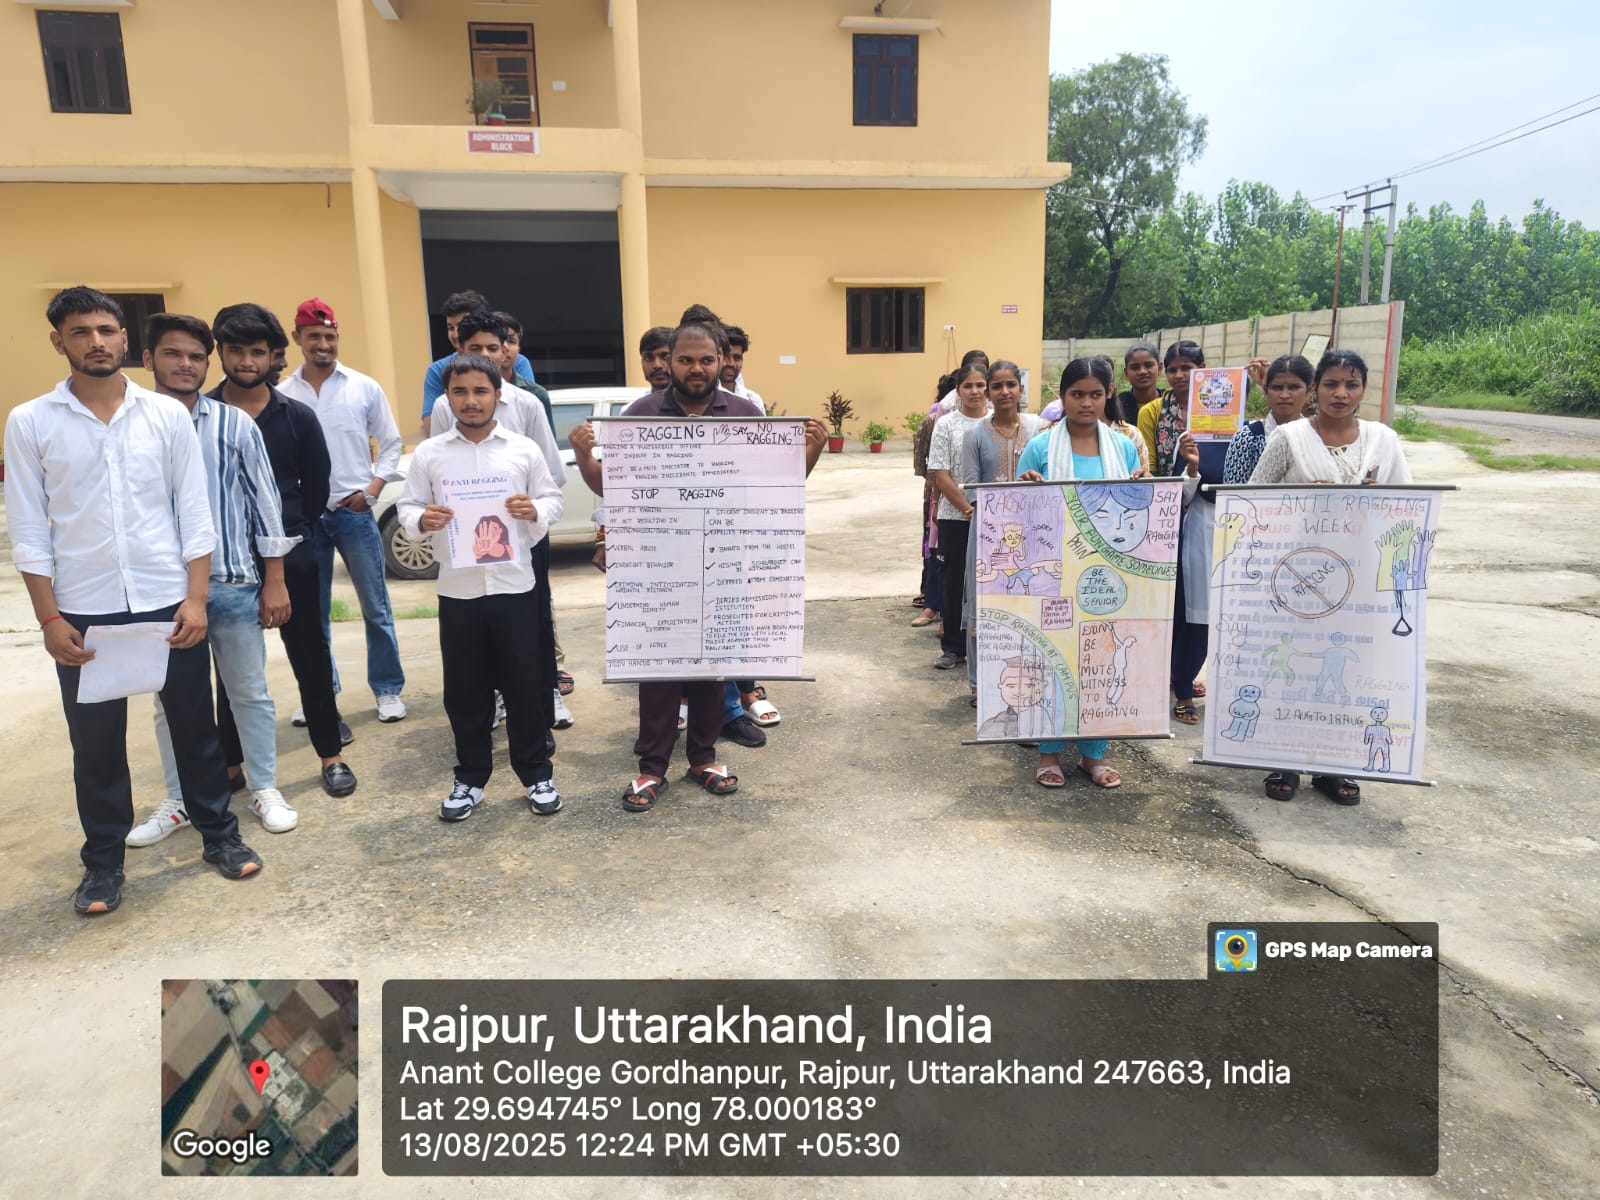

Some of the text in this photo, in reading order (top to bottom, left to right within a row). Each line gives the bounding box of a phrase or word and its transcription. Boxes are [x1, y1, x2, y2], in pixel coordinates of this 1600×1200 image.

[472, 132, 530, 143] ADMINISTRATION
[490, 143, 513, 151] BLOCK
[635, 424, 705, 442] RAGGING
[731, 423, 805, 436] SAY NO TO
[746, 432, 792, 445] RAGGING
[631, 488, 724, 502] STOP RAGGING
[1154, 490, 1179, 503] SAY
[1278, 493, 1425, 514] ANTI RAGGING
[1066, 495, 1089, 527] YOUR
[1159, 504, 1179, 517] NO
[709, 518, 735, 526] CAN BE
[1157, 518, 1175, 529] TO
[1304, 518, 1353, 535] WEEK
[1091, 568, 1105, 577] BE
[1085, 577, 1108, 586] THE
[1081, 586, 1116, 595] IDEAL
[741, 593, 778, 602] ADMISSION
[1083, 596, 1119, 607] SENIOR
[1269, 593, 1288, 613] NO
[713, 612, 753, 620] PROSECUTED
[980, 609, 1009, 621] STOP
[1010, 618, 1048, 649] RAGGING
[1048, 648, 1058, 658] AT
[616, 644, 629, 652] USE
[1083, 638, 1097, 652] BE
[1083, 653, 1091, 665] A
[1081, 664, 1113, 677] MUTE
[1081, 678, 1127, 690] WITNESS
[1084, 692, 1100, 703] TO
[1080, 705, 1138, 724] RAGGING
[1274, 707, 1291, 720] 12
[1294, 708, 1313, 722] AUG
[1328, 713, 1342, 725] 18
